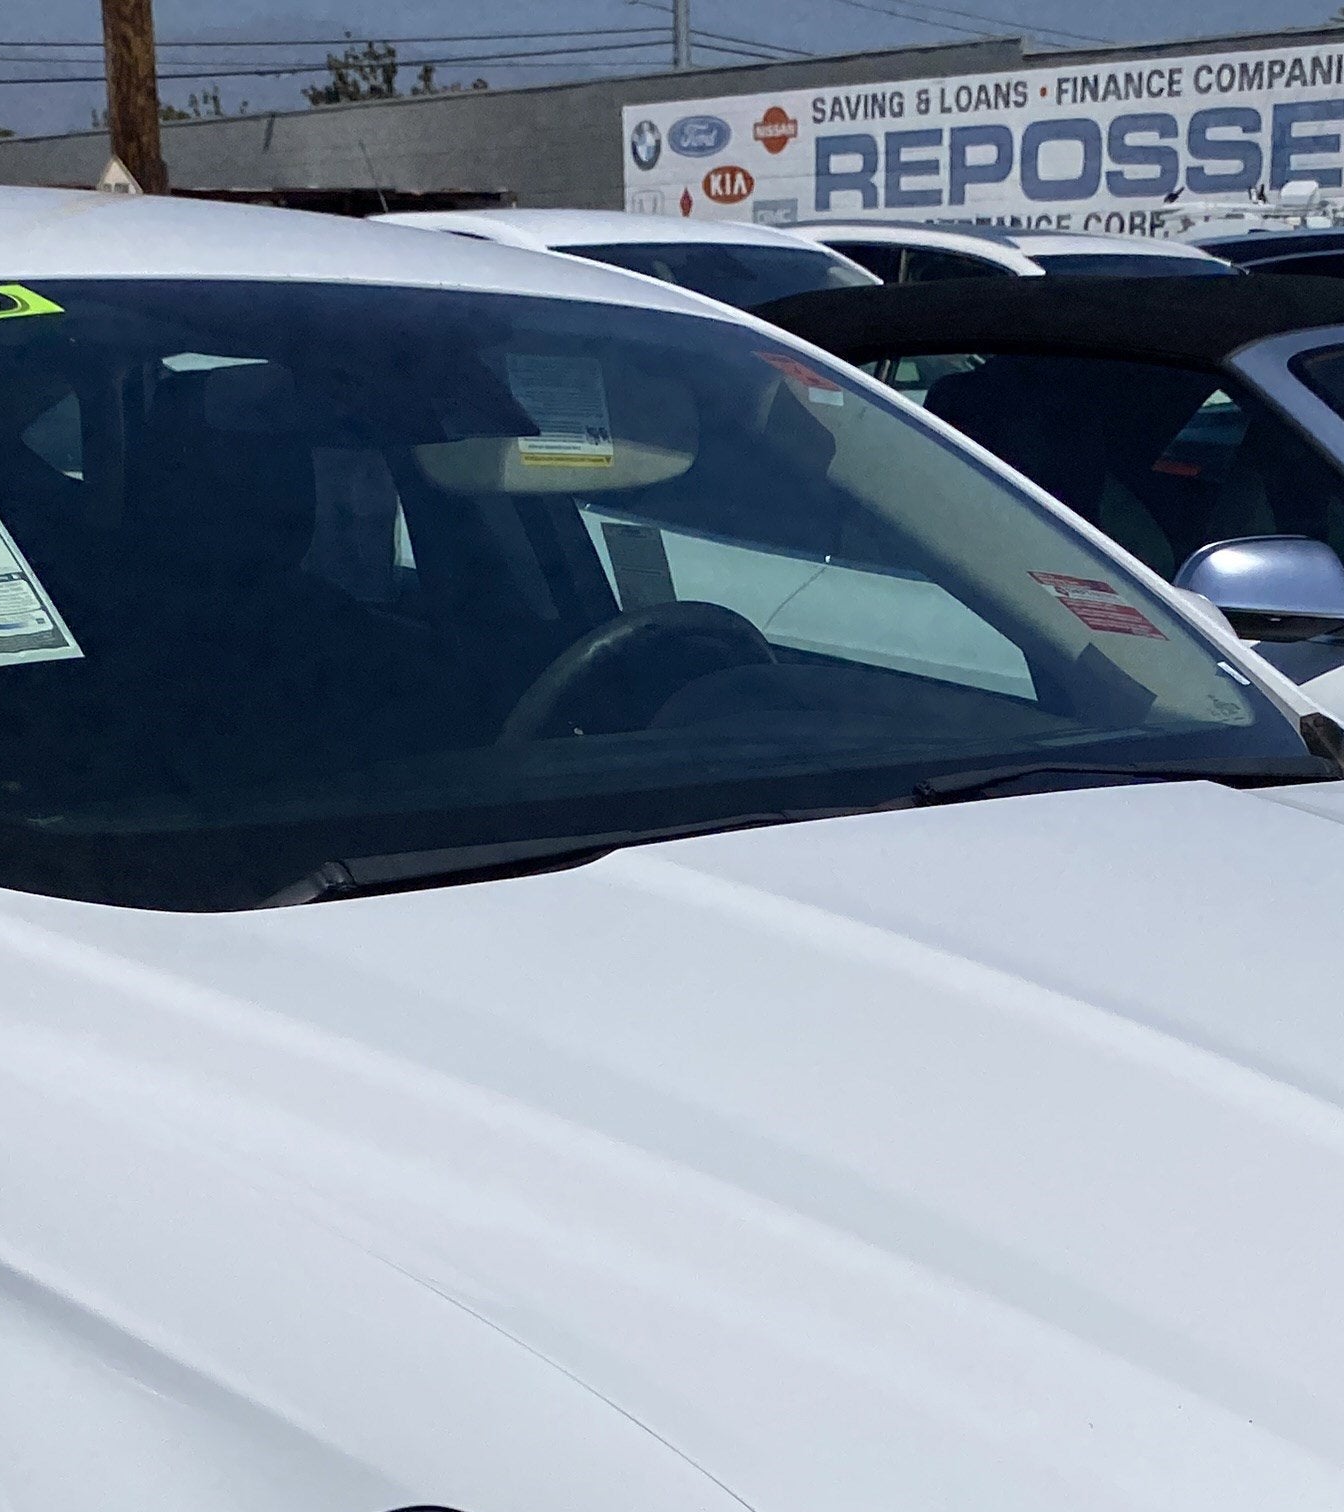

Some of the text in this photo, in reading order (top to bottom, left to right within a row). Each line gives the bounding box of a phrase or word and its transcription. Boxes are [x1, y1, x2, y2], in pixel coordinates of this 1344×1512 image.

[812, 93, 904, 124] SAVING
[916, 89, 930, 115] &
[940, 80, 1028, 113] LOANS
[1056, 68, 1183, 104] FINANCE
[710, 172, 747, 196] KIA
